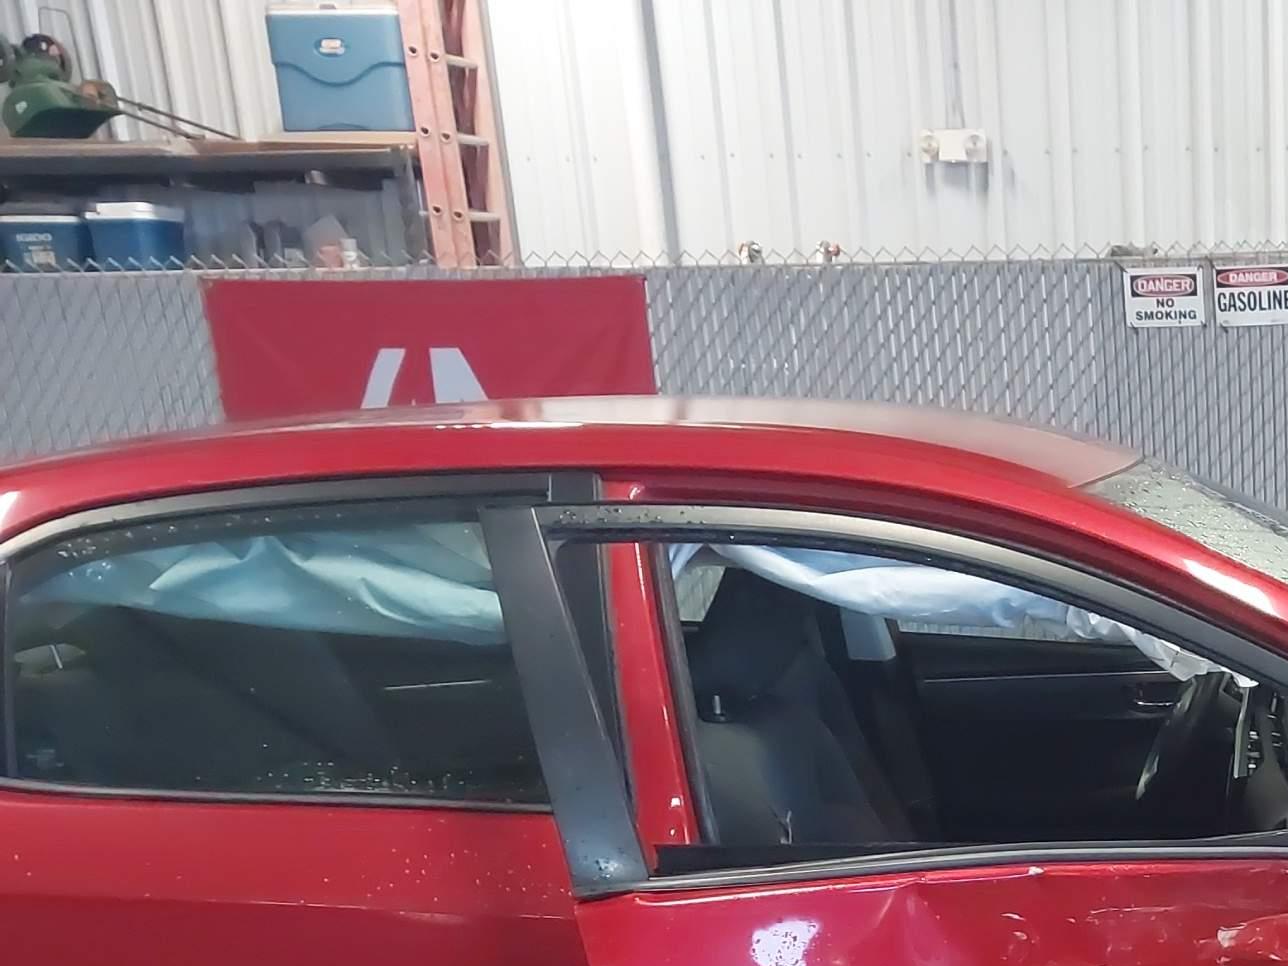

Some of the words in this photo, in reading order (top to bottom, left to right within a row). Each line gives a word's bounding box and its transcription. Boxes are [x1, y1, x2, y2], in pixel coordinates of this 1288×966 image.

[1228, 272, 1278, 283] DANGER
[1138, 279, 1191, 292] DANGER
[1156, 298, 1175, 308] NO
[1135, 310, 1197, 321] SMOKING
